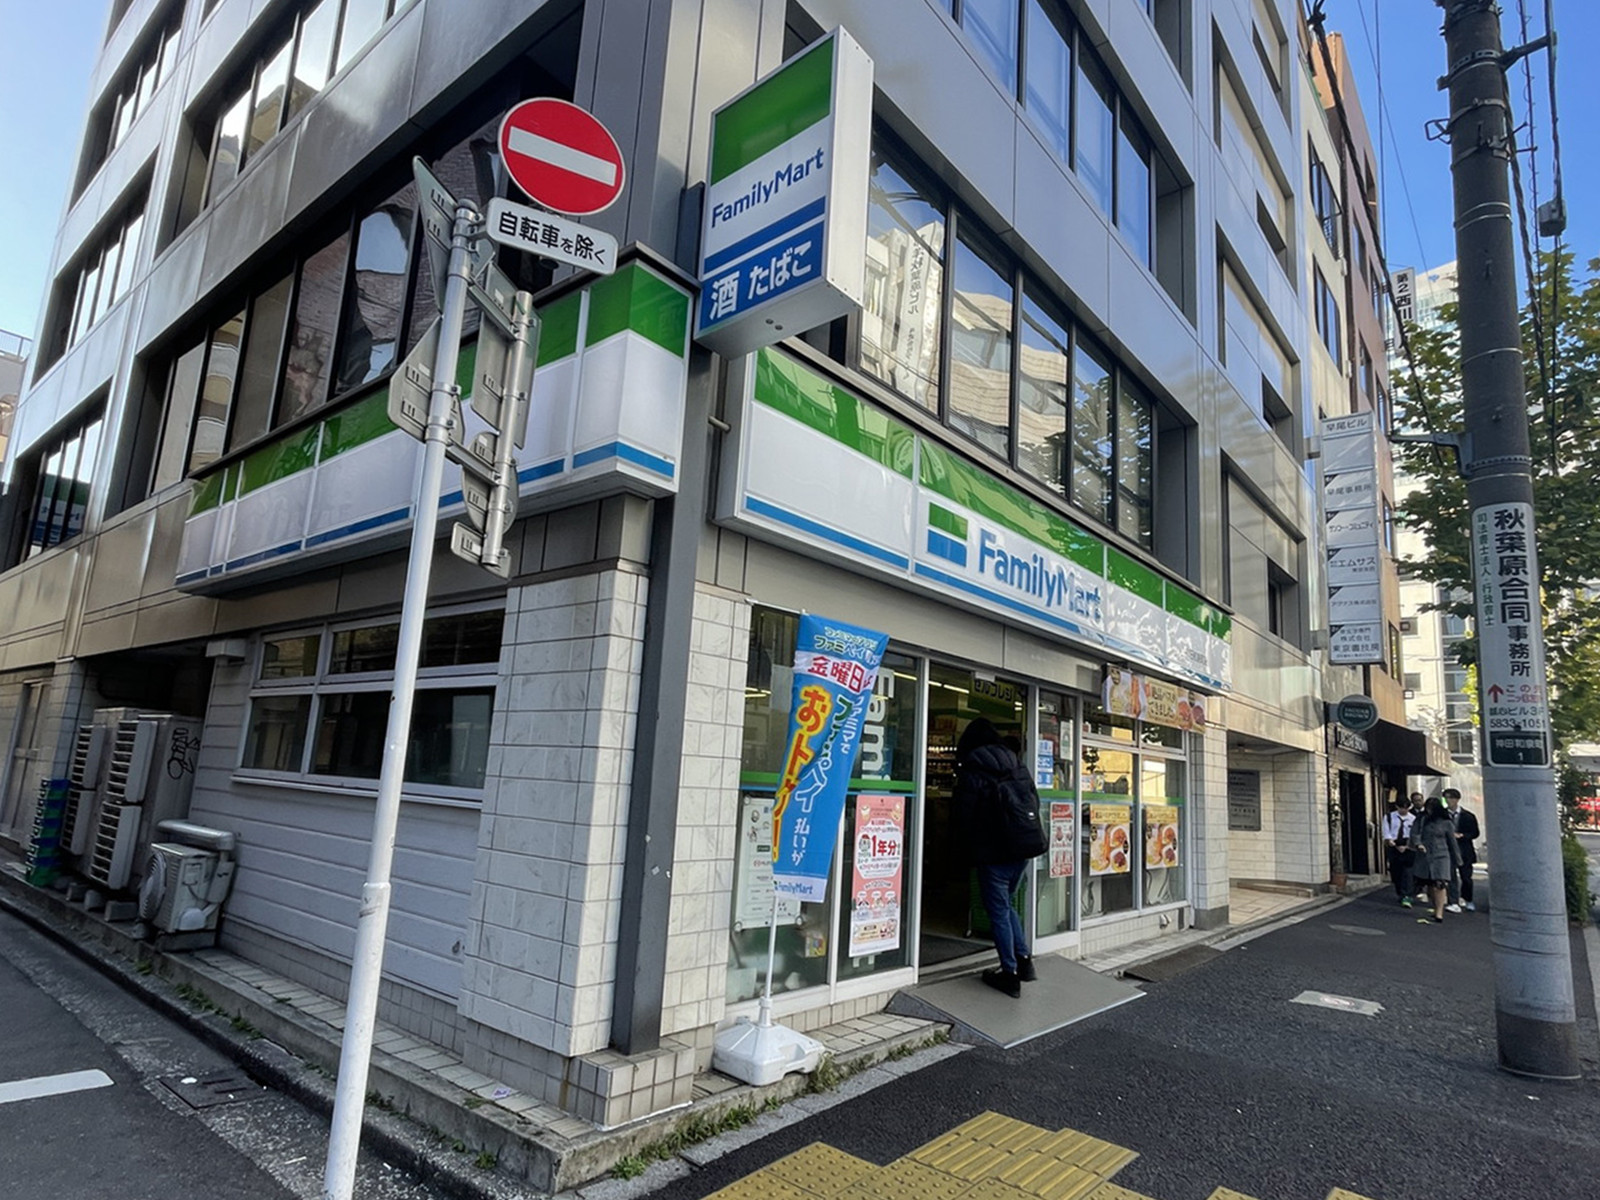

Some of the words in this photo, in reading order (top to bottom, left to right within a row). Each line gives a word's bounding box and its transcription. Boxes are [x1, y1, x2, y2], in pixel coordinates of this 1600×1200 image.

[711, 148, 825, 228] FamilyMart
[499, 211, 605, 265] 自転車を除く
[709, 271, 740, 320] 酒
[748, 240, 812, 300] たばこ
[978, 528, 1102, 619] FamilyMart
[1494, 508, 1530, 677] 秋葉原合同事務所
[1490, 718, 1546, 729] 5833-1051
[791, 817, 810, 866] 払いが
